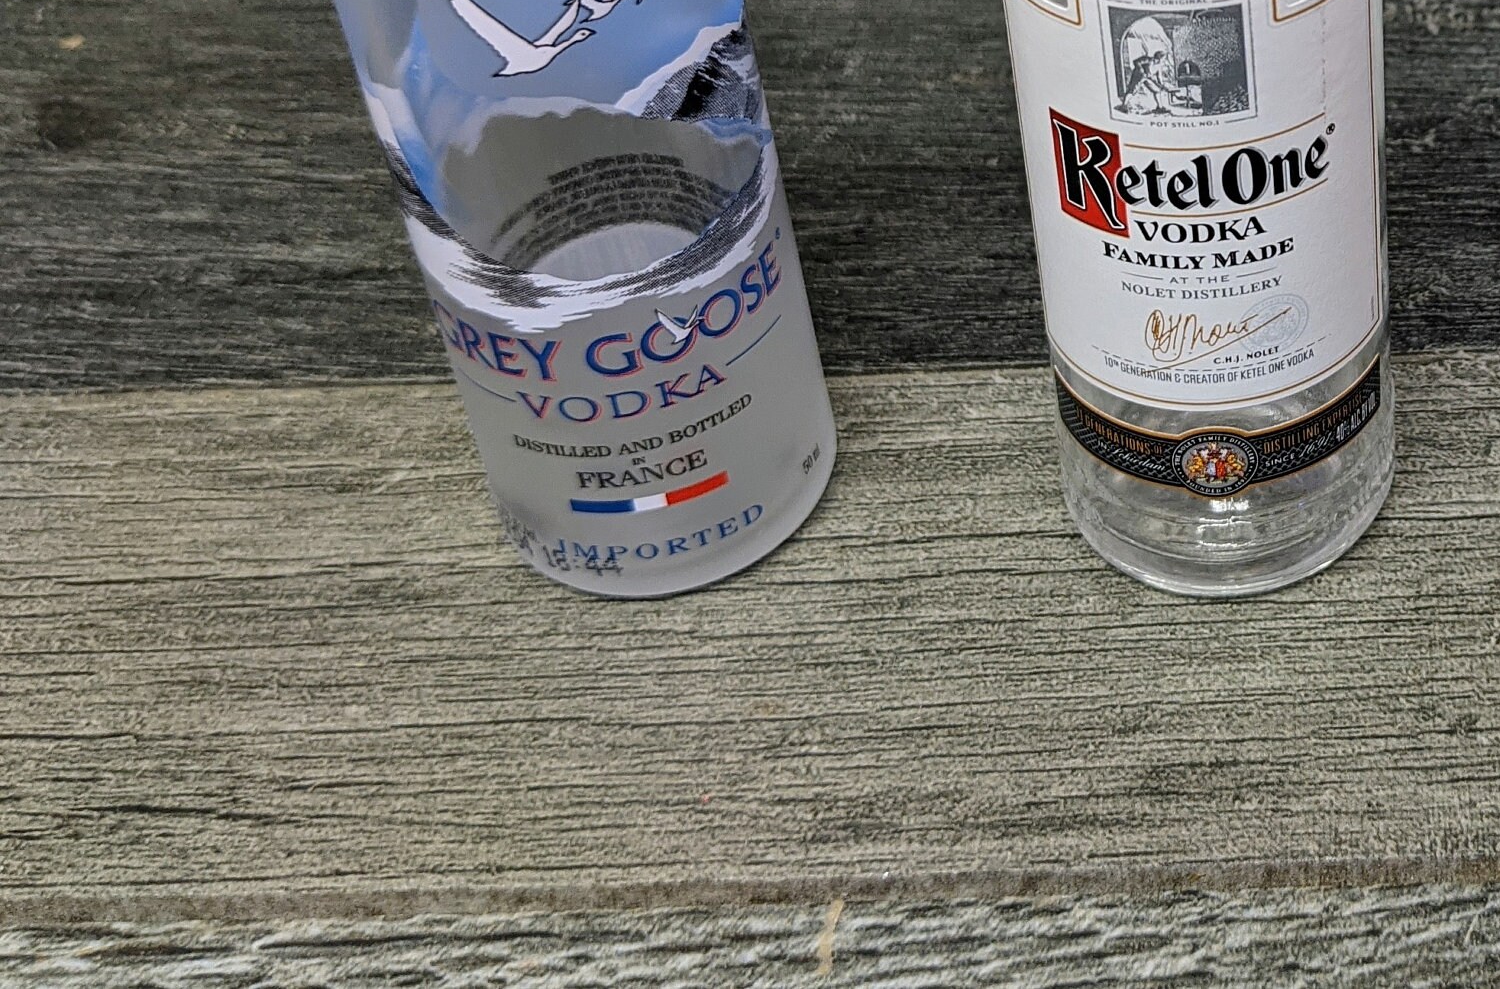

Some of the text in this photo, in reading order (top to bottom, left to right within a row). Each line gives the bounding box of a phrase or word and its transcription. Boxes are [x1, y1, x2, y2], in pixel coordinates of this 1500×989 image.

[1052, 118, 1218, 231] Ketel
[1134, 216, 1267, 244] VODKA
[1102, 237, 1295, 269] FAMILY MADE
[1121, 275, 1283, 300] NOLET DISTILLERY
[1195, 275, 1230, 284] THE
[433, 241, 783, 382] GREY GOOSE
[1120, 362, 1172, 383] GENERATION
[1174, 373, 1182, 383] &
[1183, 372, 1225, 384] CREATOR
[1227, 371, 1239, 382] OF
[1240, 365, 1267, 380] KETEL
[1268, 360, 1285, 373] ONE
[1287, 349, 1315, 368] VODKA
[1246, 345, 1280, 360] NOLET
[515, 363, 728, 423] VODKA
[513, 393, 752, 458] DISTILLED AND BOTTLED
[576, 448, 708, 489] FRANCE
[632, 456, 646, 466] IN
[558, 503, 765, 561] IMPORTED
